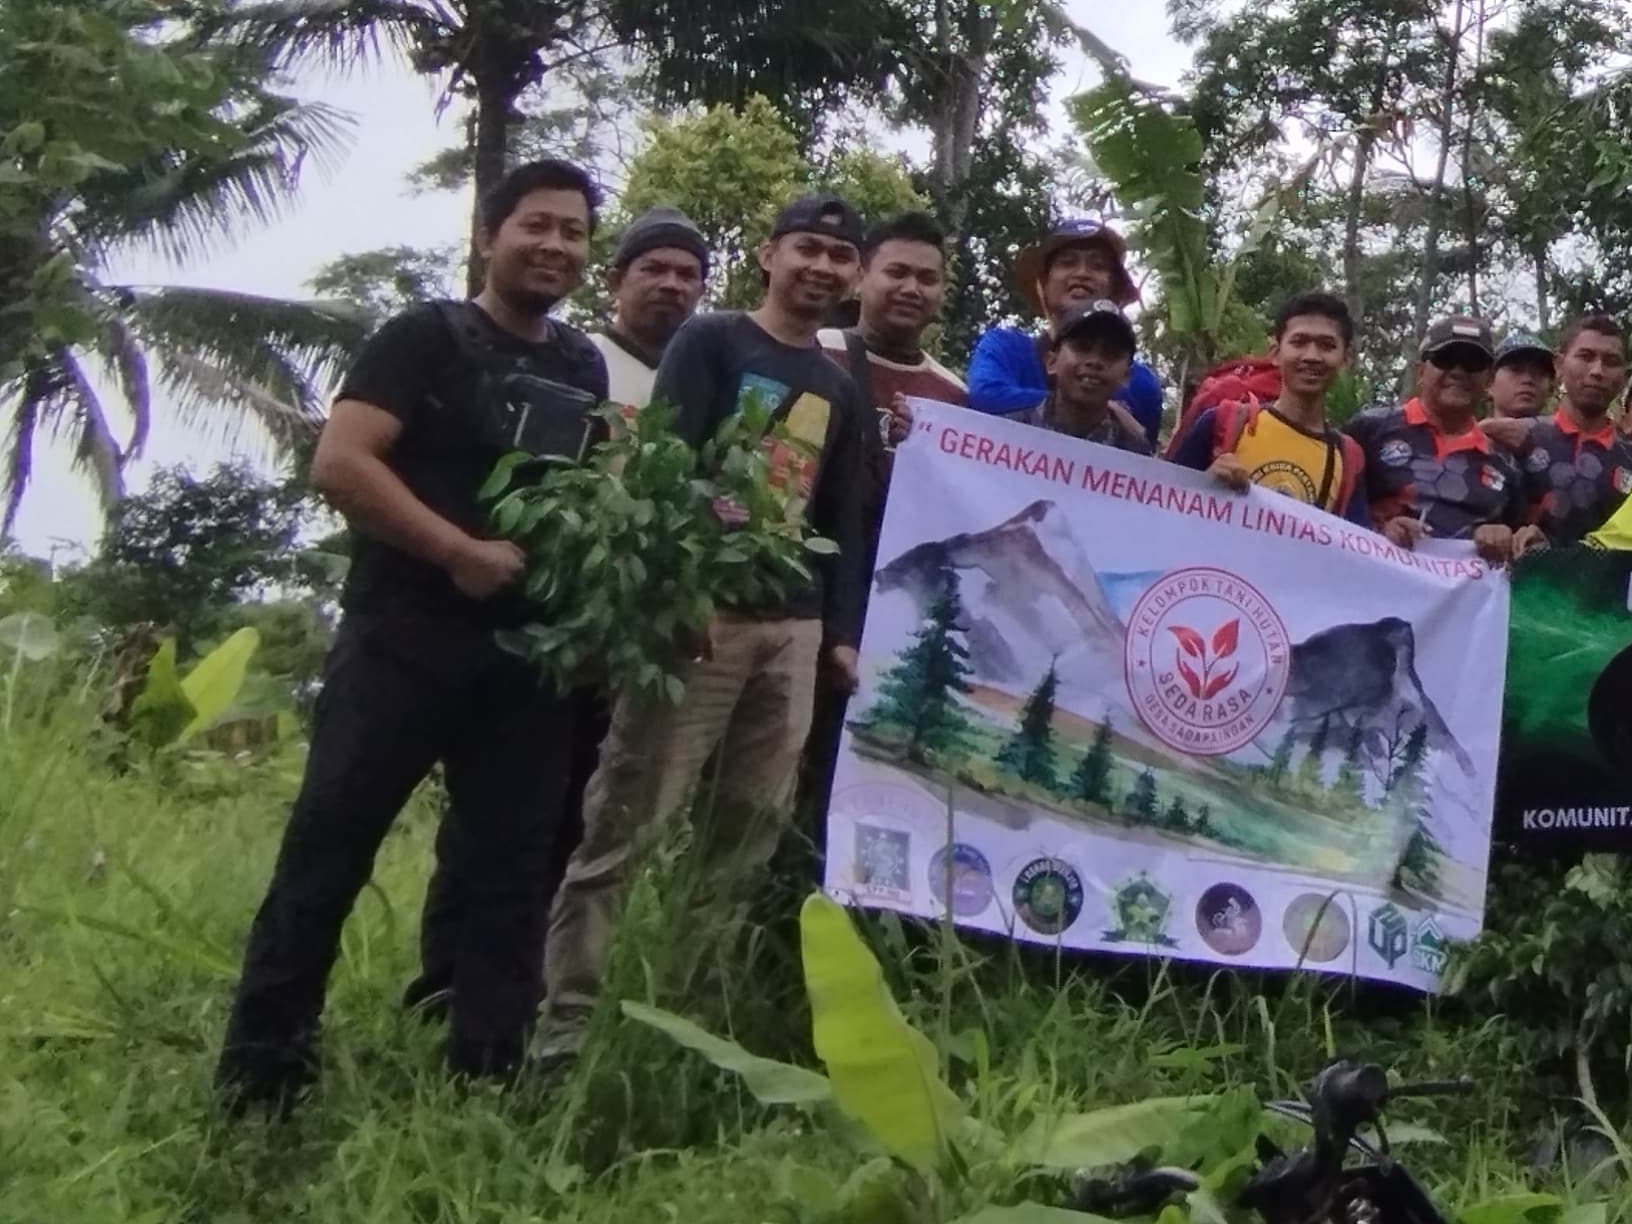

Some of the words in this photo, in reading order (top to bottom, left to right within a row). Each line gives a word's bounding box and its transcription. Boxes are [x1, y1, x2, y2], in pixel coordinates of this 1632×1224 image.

[939, 427, 1075, 485] GERAKAN
[1081, 465, 1232, 525] MENANAM
[1242, 510, 1332, 546] LINTAS
[1137, 578, 1210, 638] KELOMPOK
